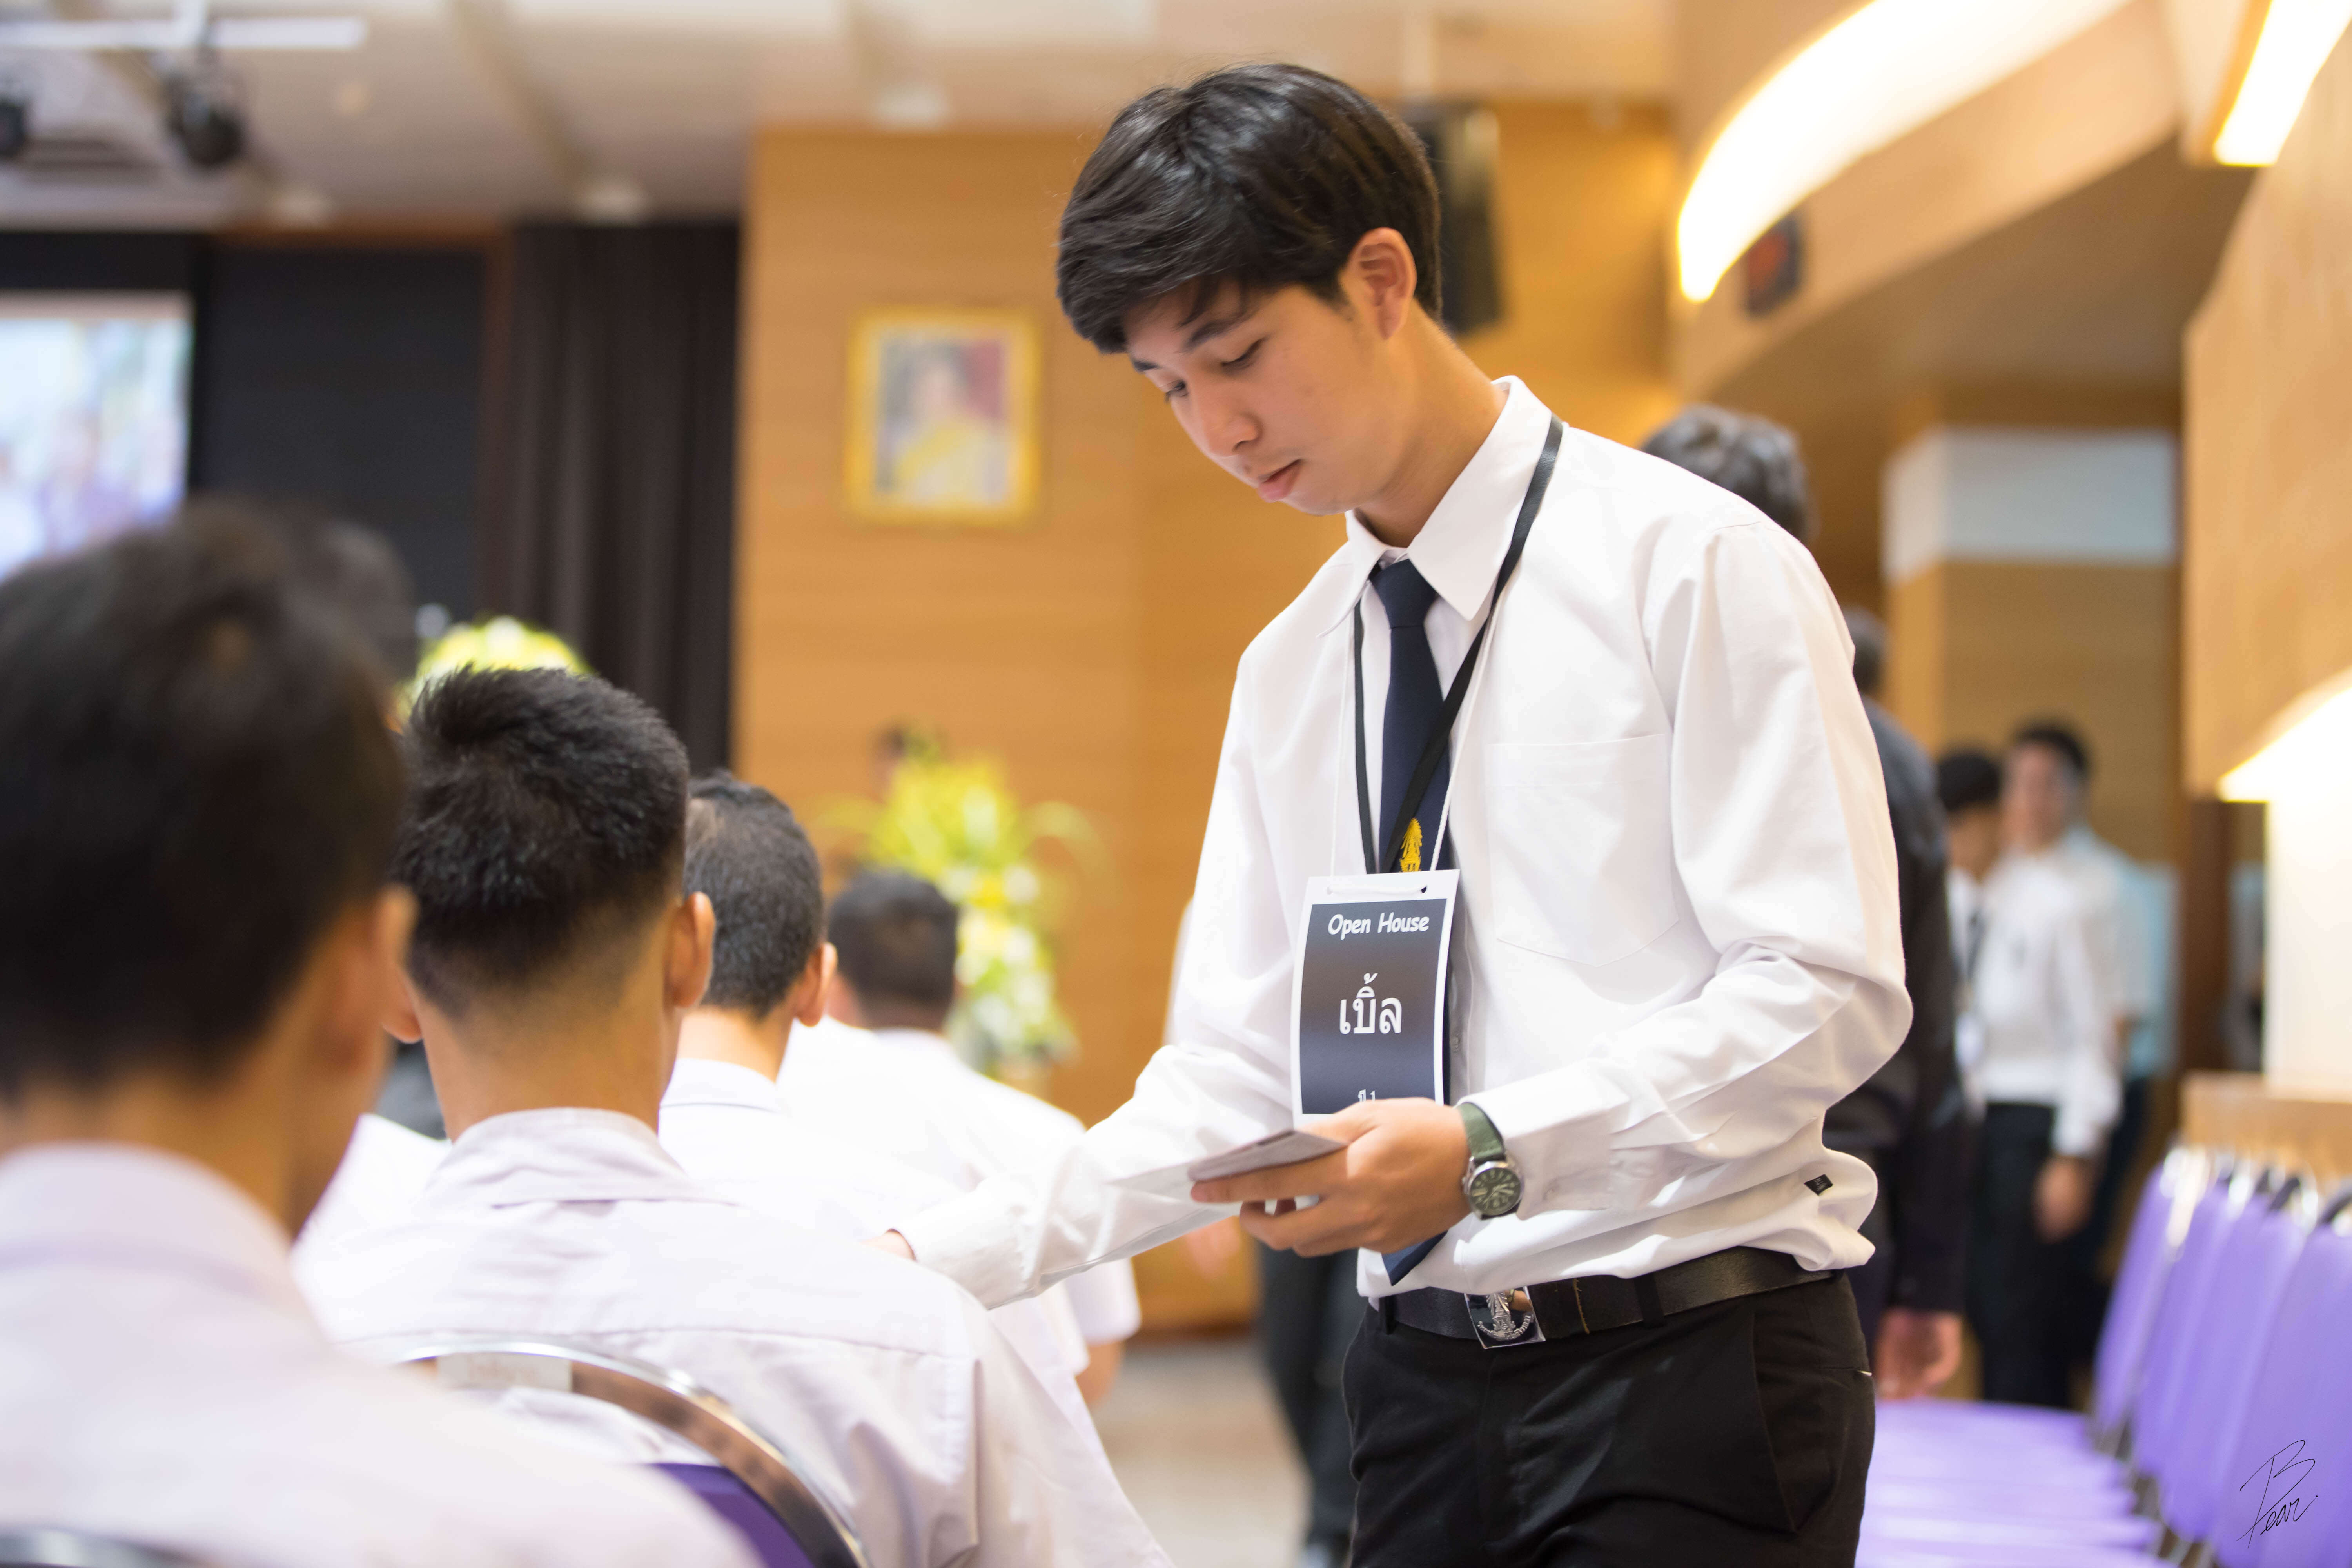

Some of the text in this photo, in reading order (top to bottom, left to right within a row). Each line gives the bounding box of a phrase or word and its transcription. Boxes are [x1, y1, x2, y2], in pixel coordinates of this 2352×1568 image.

[1328, 912, 1430, 940] Open House
[1339, 973, 1402, 1034] เบิ้ล
